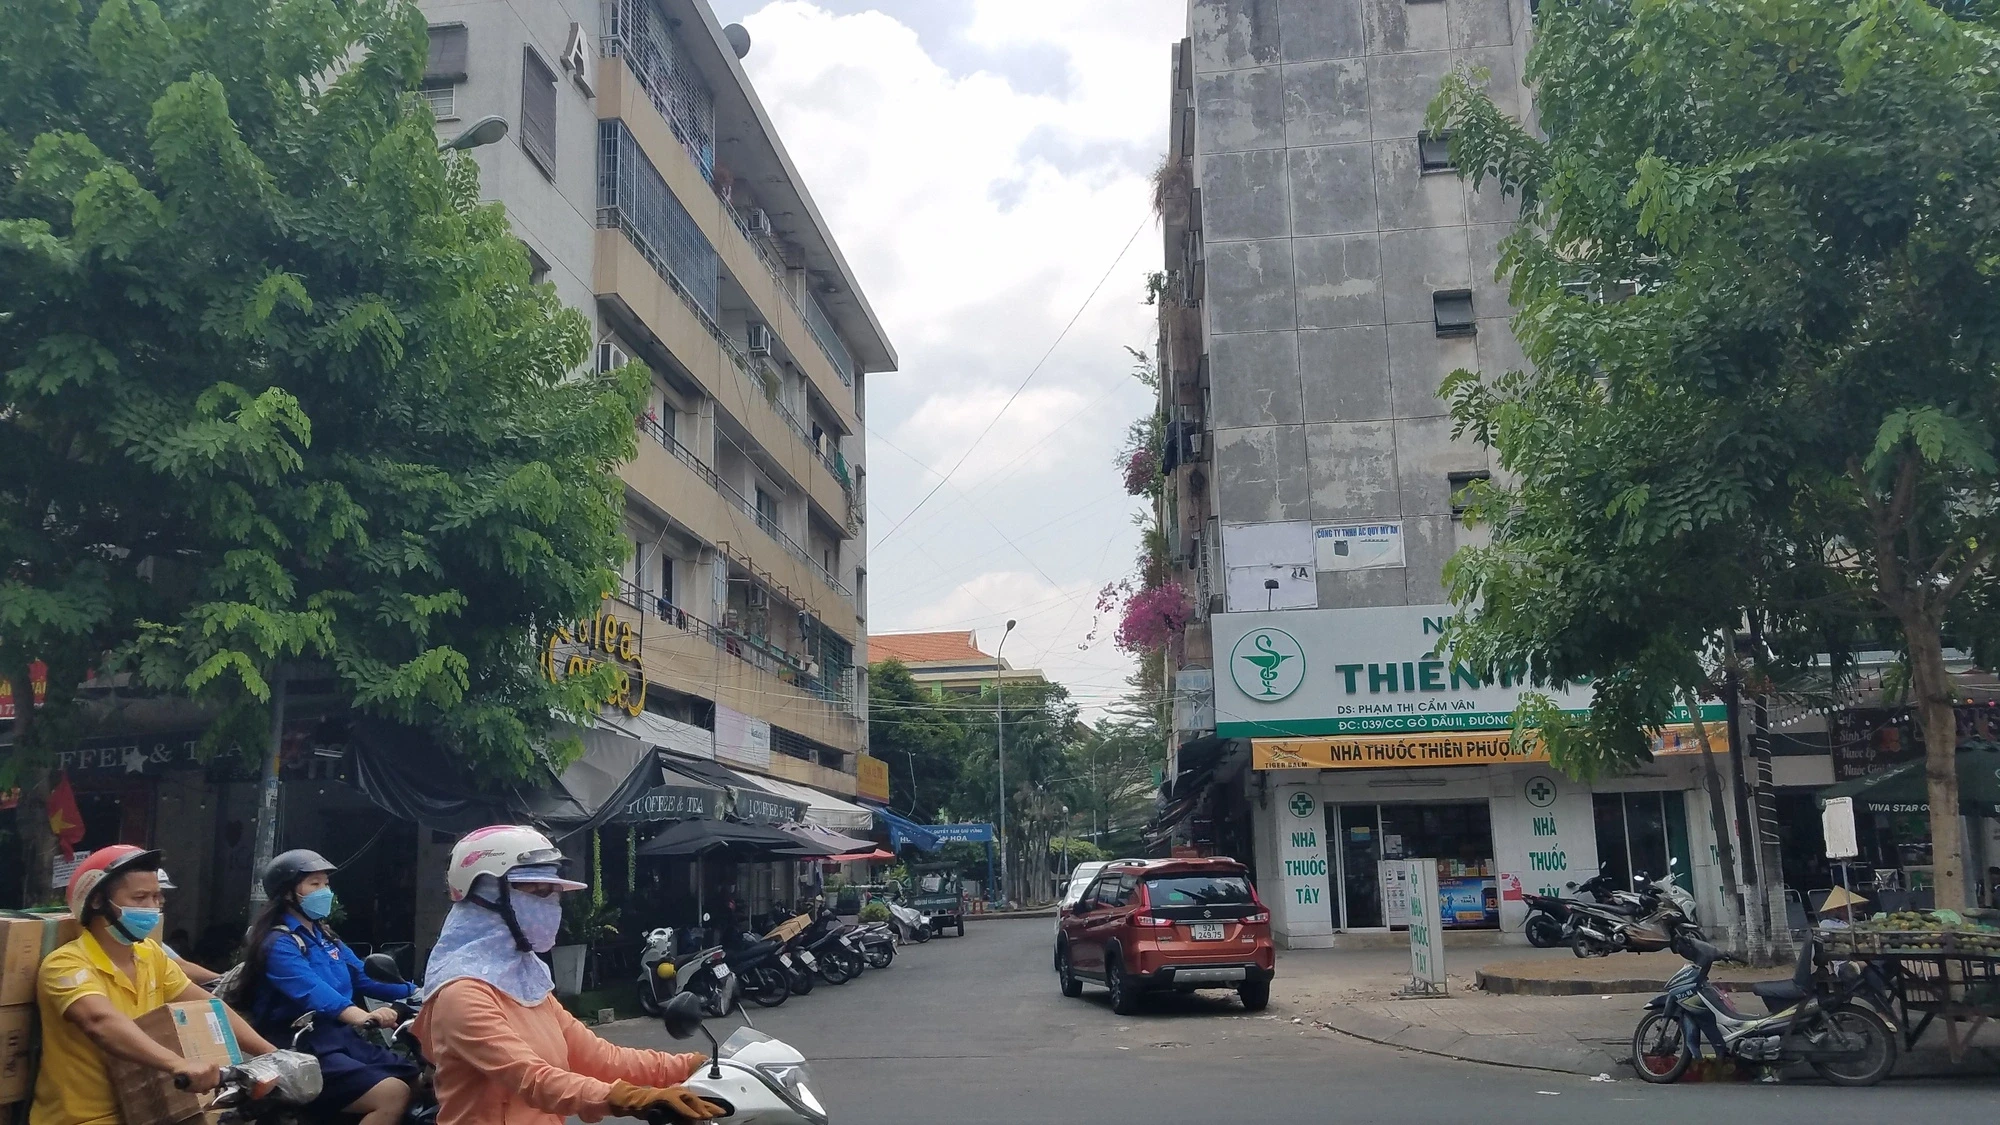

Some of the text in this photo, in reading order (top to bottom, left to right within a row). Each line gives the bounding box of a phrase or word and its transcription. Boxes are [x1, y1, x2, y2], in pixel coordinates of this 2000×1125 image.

[1337, 699, 1475, 715] DS: PHẠM THỊ CẨM VÂN
[1407, 716, 1428, 728] GÒ
[1330, 743, 1362, 761] NHÀ
[1366, 739, 1418, 761] THUỐC
[1420, 740, 1463, 759] THIÊN
[1868, 803, 1890, 812] VIVA
[1892, 804, 1919, 812] STAR
[1532, 811, 1557, 836] NHÀ
[1291, 827, 1317, 848] NHÀ
[1284, 853, 1327, 876] THUỐC
[1528, 842, 1567, 871] THUỐC
[1295, 884, 1320, 904] TÂY
[1198, 931, 1222, 939] 249.75
[1203, 924, 1216, 932] 92A
